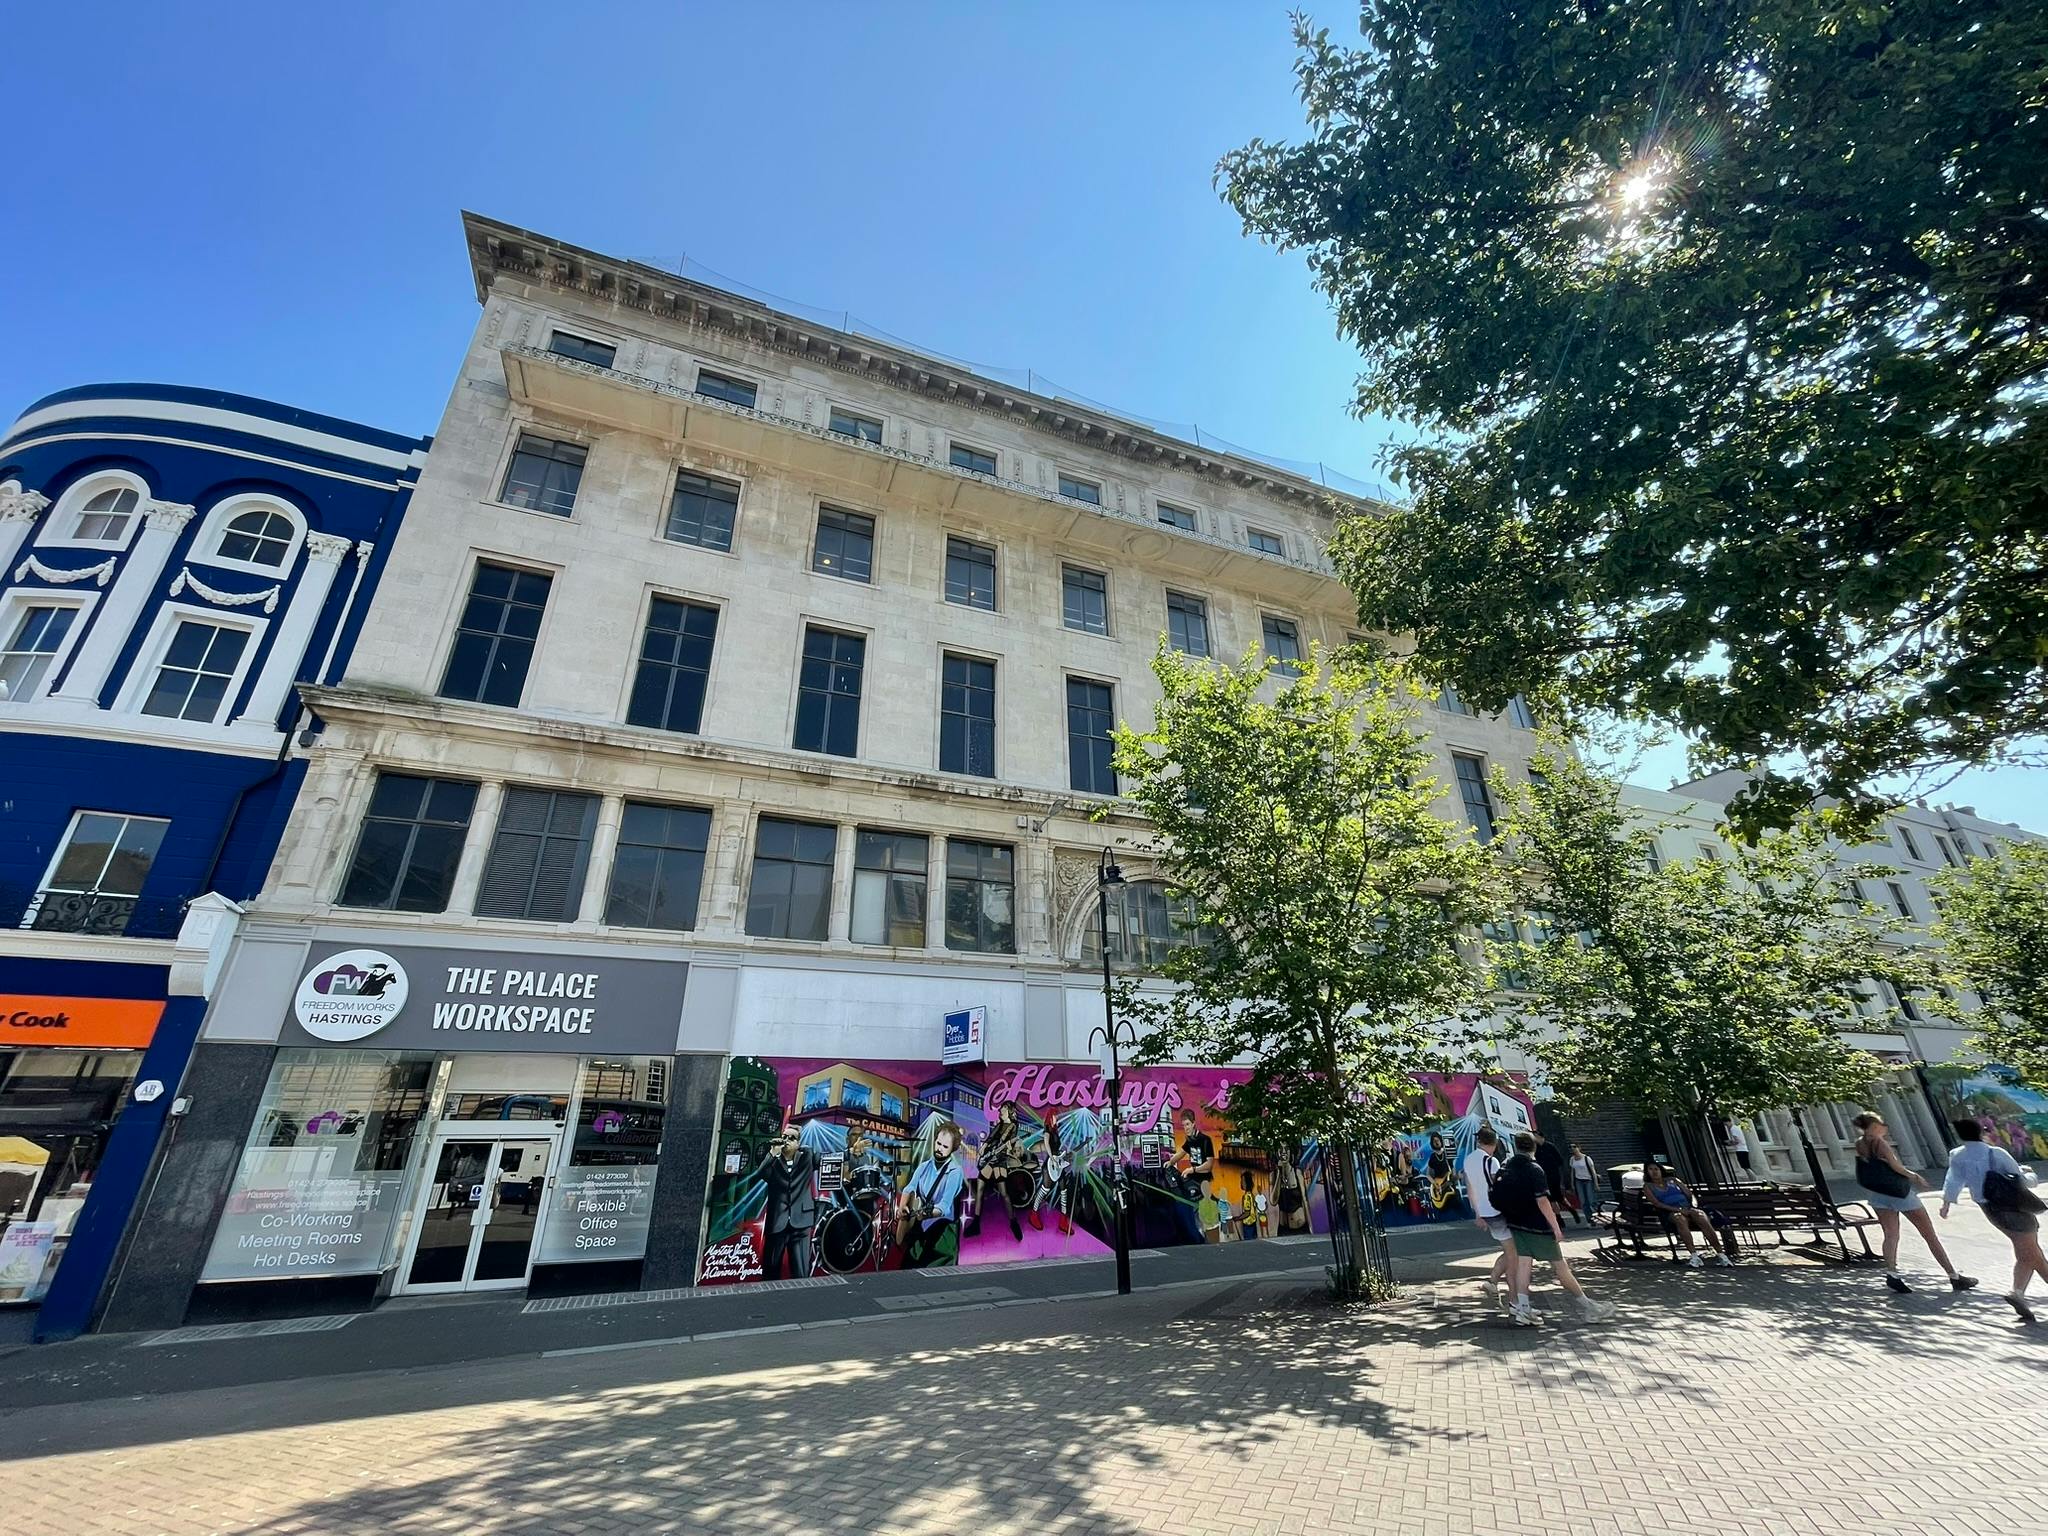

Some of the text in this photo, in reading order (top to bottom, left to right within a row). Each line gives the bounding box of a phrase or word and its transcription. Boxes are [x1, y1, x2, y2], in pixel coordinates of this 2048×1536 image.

[446, 966, 599, 999] THE PALACE
[302, 1000, 396, 1012] FREEDOM WORKS
[9, 1011, 70, 1028] Cook
[309, 1013, 383, 1026] HASTINGS
[432, 1003, 595, 1034] WORKSPACE
[946, 1024, 960, 1035] Dyer
[971, 1020, 979, 1045] LET
[983, 1065, 1182, 1133] Hastngs
[862, 1119, 905, 1136] CARLISLE
[577, 1200, 627, 1212] Flexible
[260, 1213, 353, 1228] Co-Working
[580, 1217, 618, 1230] Office
[238, 1231, 363, 1248] Meeting Rooms
[575, 1235, 617, 1250] Space
[253, 1251, 337, 1268] Hot Desks
[752, 1253, 759, 1264] &
